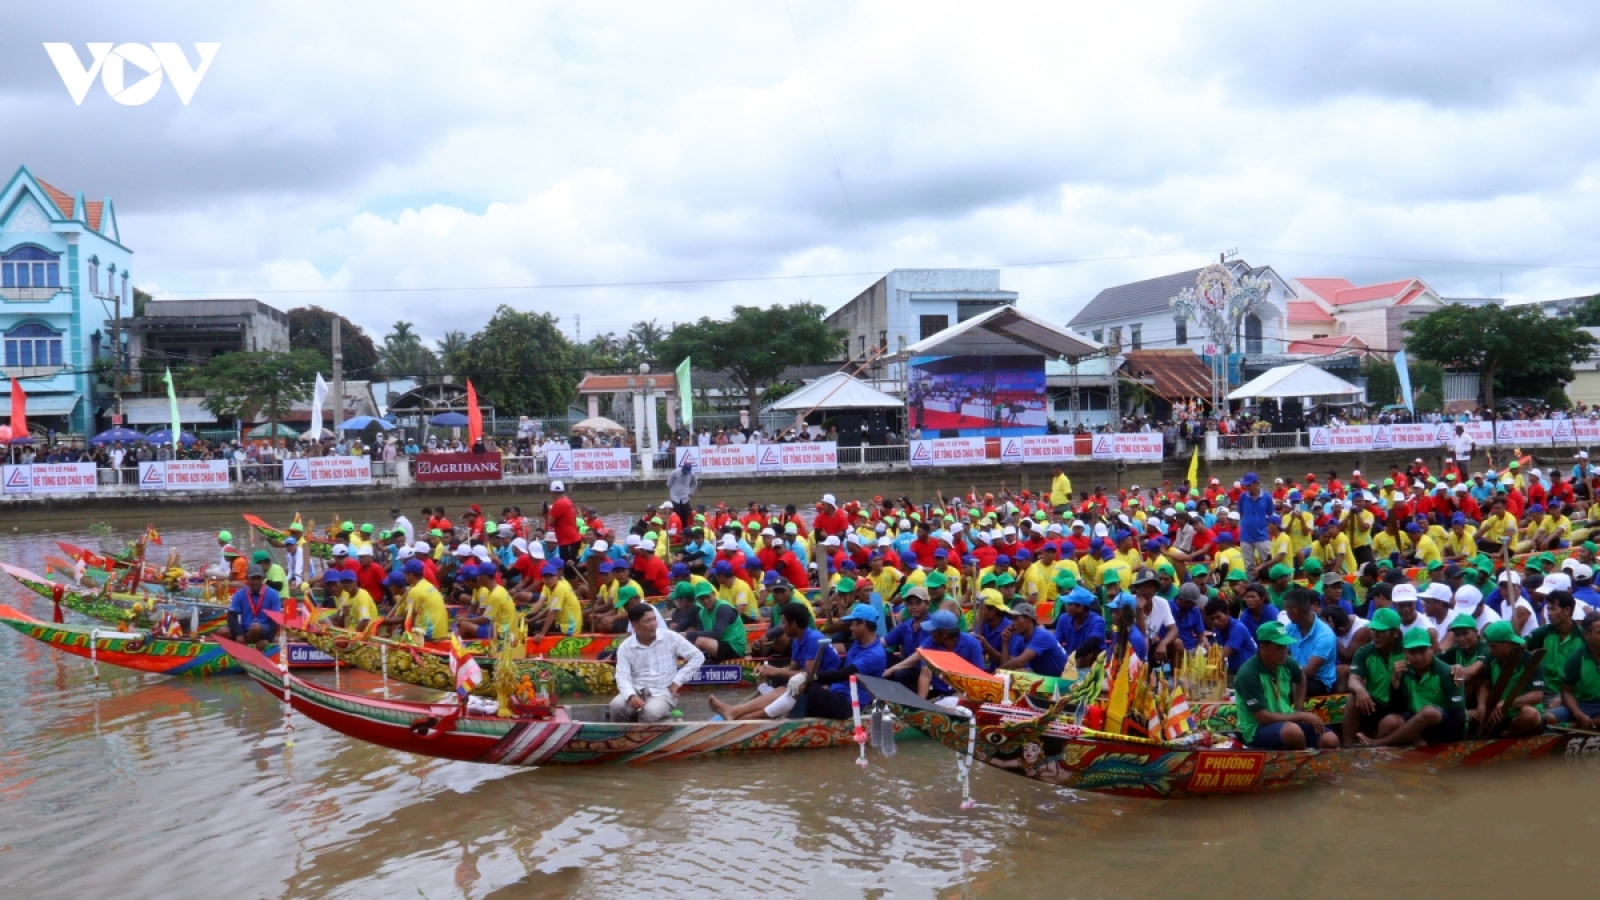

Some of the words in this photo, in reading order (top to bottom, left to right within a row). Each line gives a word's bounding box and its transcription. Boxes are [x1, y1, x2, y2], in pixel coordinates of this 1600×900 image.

[432, 462, 499, 473] AGRIBANK
[722, 670, 738, 681] LONG
[1204, 755, 1255, 769] PHƯỜNG
[1195, 771, 1220, 787] TRÀ
[1223, 773, 1254, 787] VINH
